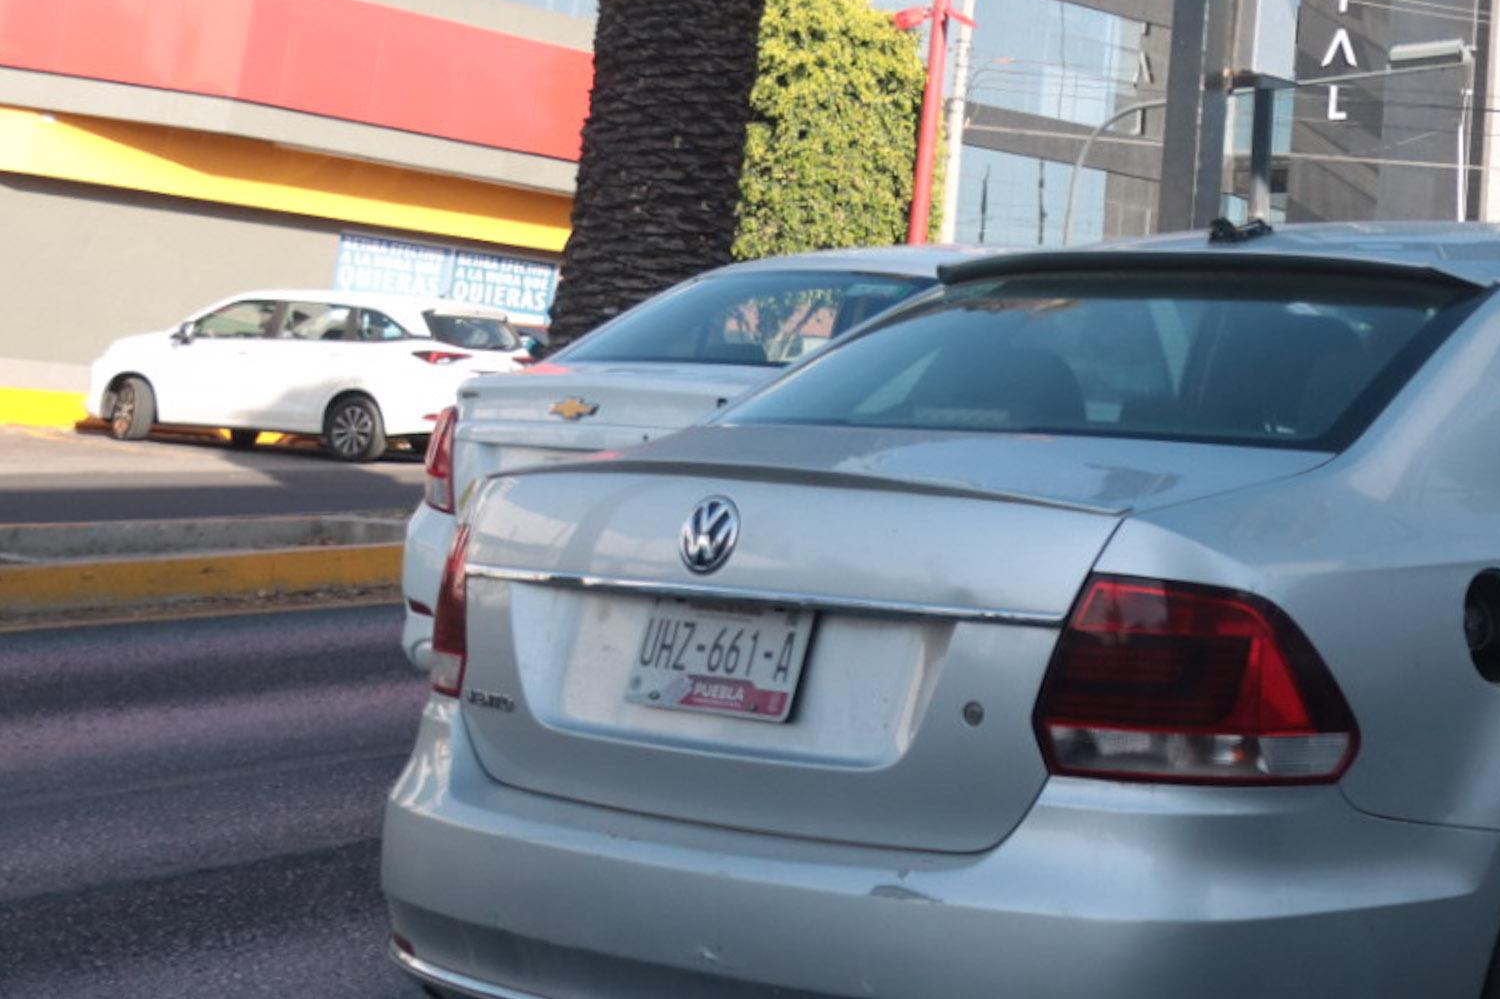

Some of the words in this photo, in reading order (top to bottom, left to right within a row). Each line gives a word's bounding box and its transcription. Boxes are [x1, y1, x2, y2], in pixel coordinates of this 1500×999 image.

[338, 265, 438, 296] QUIERAS
[453, 280, 547, 312] QUIERAS
[639, 617, 796, 683] UHZ-661-A
[693, 681, 745, 702] PUEBLA
